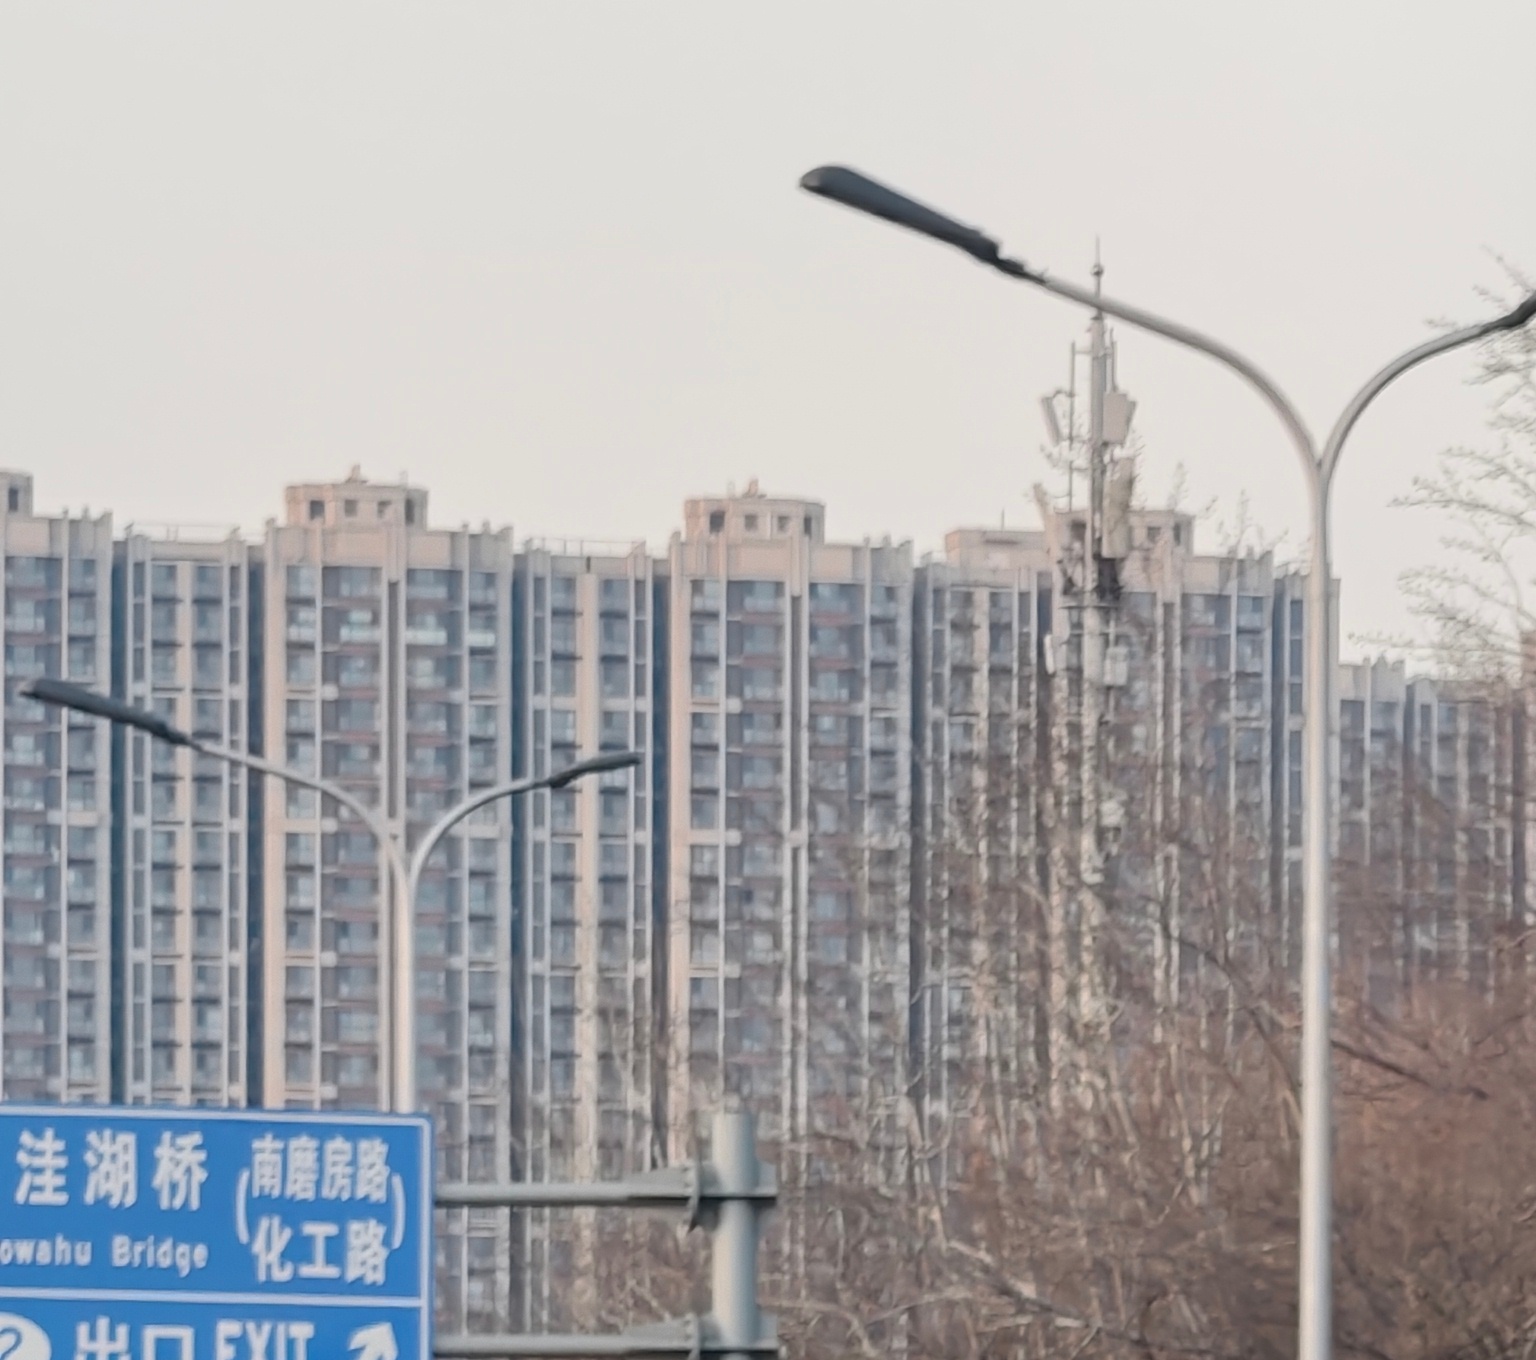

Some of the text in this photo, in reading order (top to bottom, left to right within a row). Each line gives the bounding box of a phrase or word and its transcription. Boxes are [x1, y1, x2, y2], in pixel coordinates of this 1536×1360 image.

[15, 1127, 208, 1211] 洼湖桥
[251, 1133, 391, 1203] 南磨房路
[0, 1232, 208, 1278] owahu Bridge
[251, 1214, 390, 1286] 化工路
